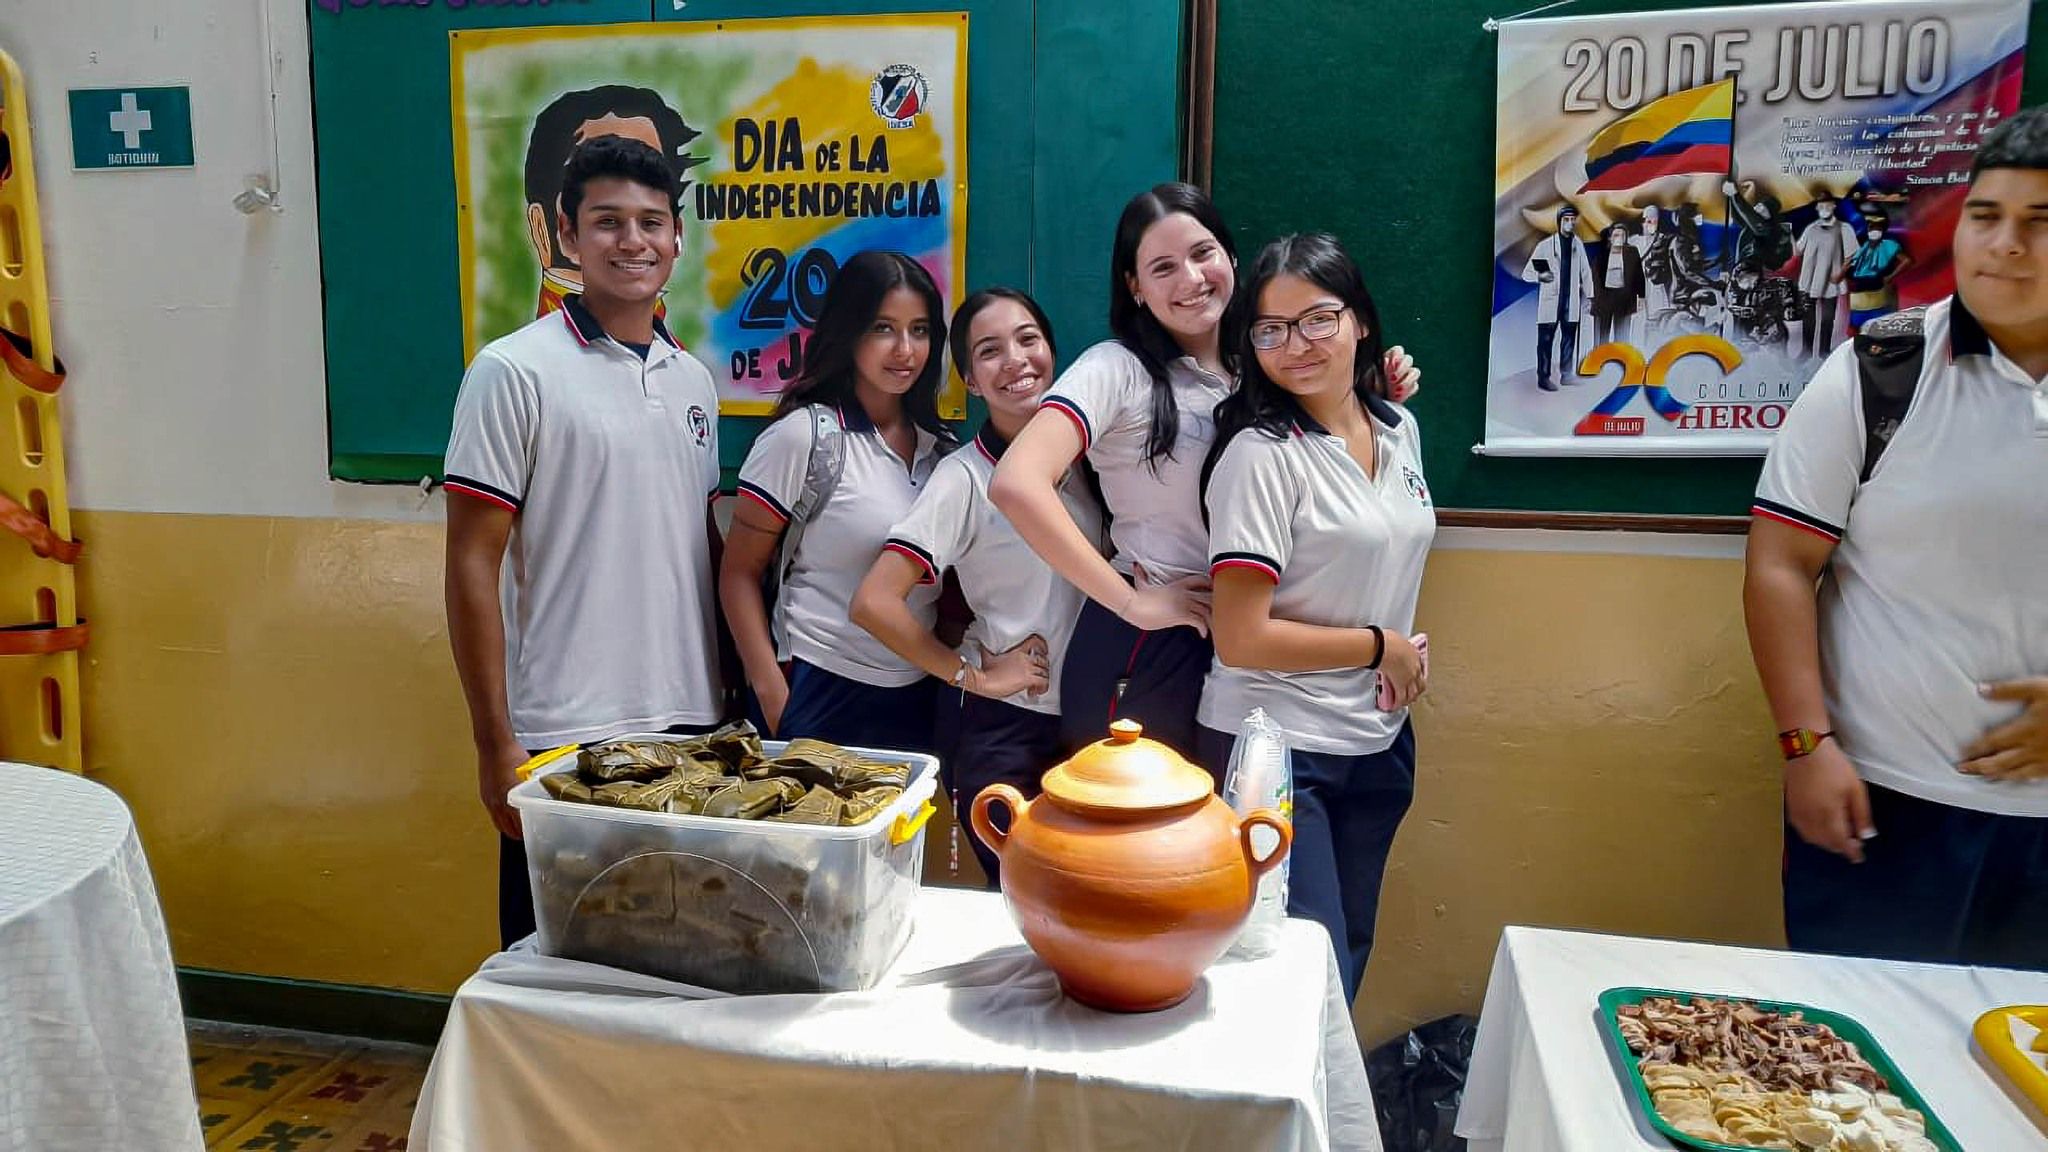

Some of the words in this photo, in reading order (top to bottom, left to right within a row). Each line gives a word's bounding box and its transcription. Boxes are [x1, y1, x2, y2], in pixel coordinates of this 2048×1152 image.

[1563, 36, 1647, 113] 20
[1667, 29, 1751, 103] DE
[1766, 17, 1951, 103] JULIO
[734, 117, 805, 173] DIA
[815, 140, 842, 173] DE
[849, 134, 890, 173] LA
[1947, 171, 1971, 184] Bol
[695, 178, 942, 221] INDEPENDENCIA
[738, 247, 838, 330] 20
[731, 348, 762, 381] DE
[1698, 381, 1809, 399] COLOM
[1676, 403, 1789, 431] HERO
